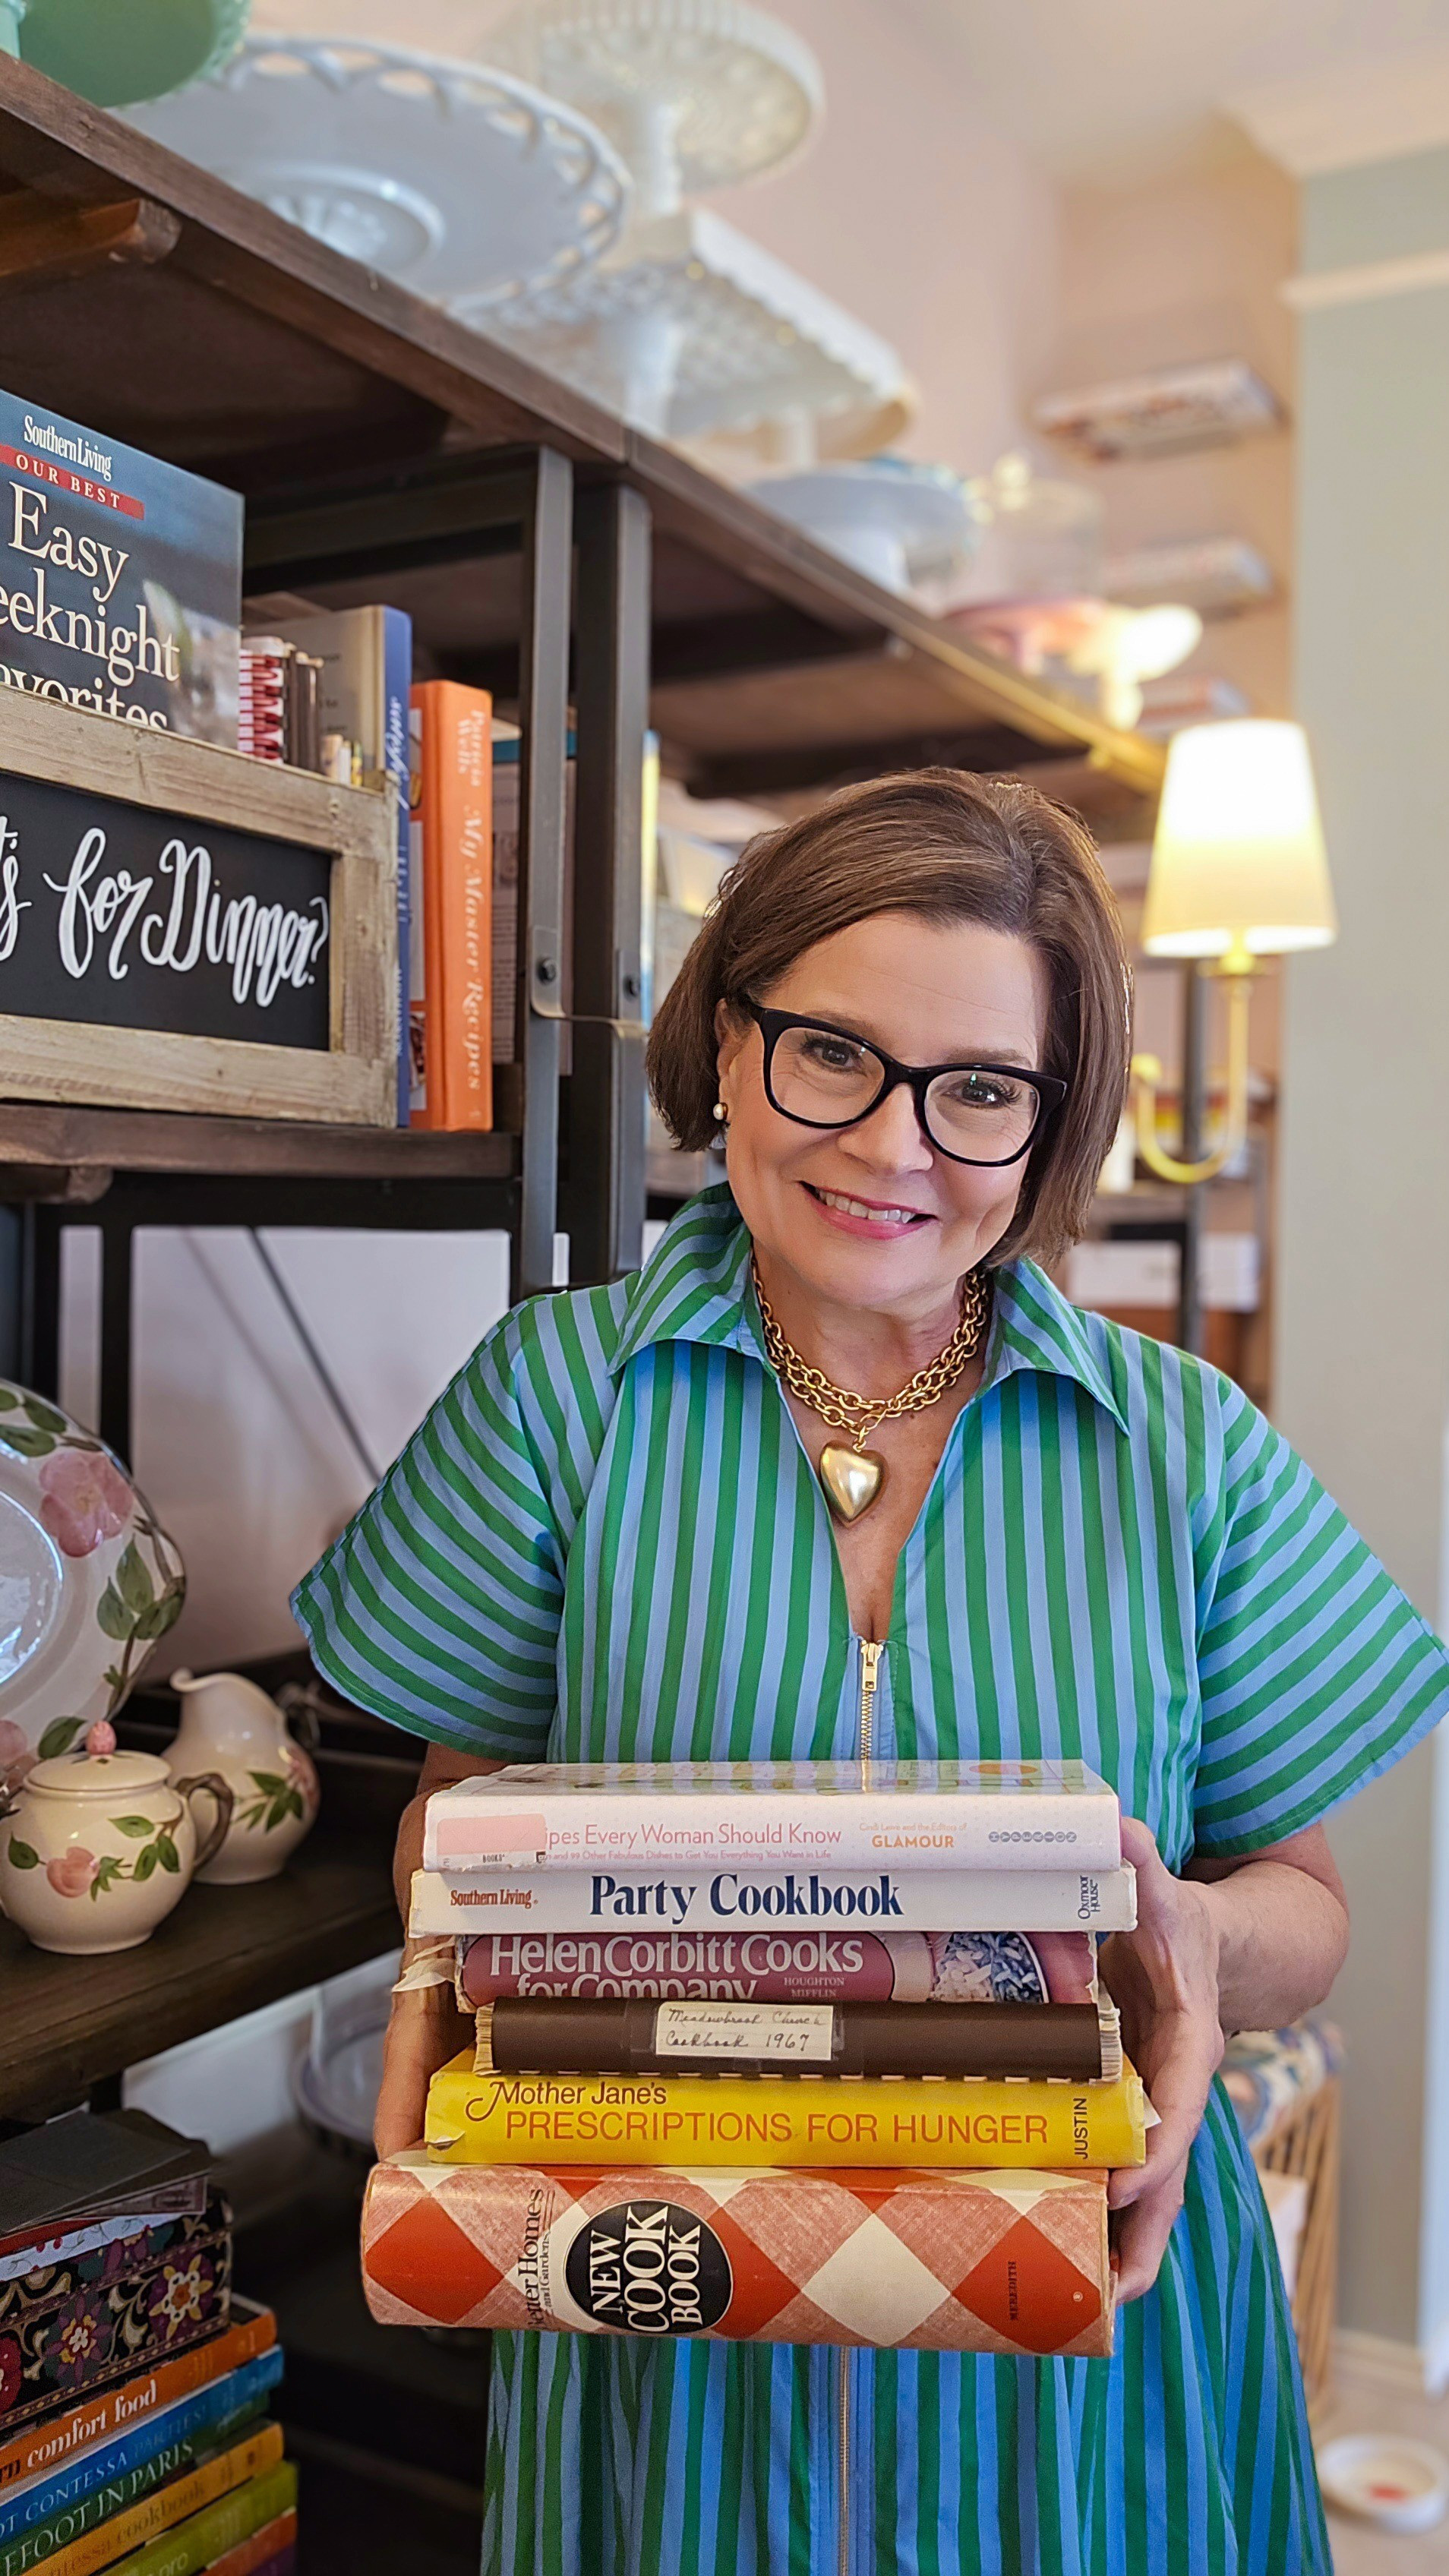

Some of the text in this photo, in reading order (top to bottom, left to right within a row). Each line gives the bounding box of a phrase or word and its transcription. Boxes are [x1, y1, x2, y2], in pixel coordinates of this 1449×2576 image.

[24, 415, 112, 481] Southern Living
[16, 454, 121, 510] OUR BEST
[8, 481, 130, 602] Easy
[458, 720, 471, 773] Wells
[470, 709, 485, 786] Patricia
[43, 827, 153, 980] for
[140, 839, 329, 1007] Dinner?
[459, 806, 485, 1089] My Master Recipes
[585, 1823, 638, 1849] Every
[641, 1823, 714, 1844] Woman
[718, 1823, 782, 1844] Should
[788, 1823, 841, 1844] Know
[872, 1835, 955, 1848] GLAMOUR
[902, 1823, 917, 1831] and
[917, 1823, 930, 1831] the
[958, 1822, 968, 1831] of
[554, 1851, 567, 1859] and
[582, 1850, 606, 1859] Other
[608, 1850, 644, 1859] Fabulous
[646, 1850, 673, 1859] Dishes
[685, 1850, 701, 1859] Get
[703, 1850, 718, 1859] You
[721, 1849, 763, 1861] Everything
[766, 1850, 781, 1858] You
[782, 1850, 803, 1858] Want
[815, 1849, 832, 1858] Life
[450, 1889, 532, 1909] Southern Living
[589, 1873, 904, 1925] Party Cookbook
[1078, 1875, 1089, 1920] Oxmoor
[491, 1933, 864, 1977] Helen Corbitt Cooks
[784, 1977, 844, 1986] HOUGHTON
[668, 2008, 826, 2026] Meadowbrook Church
[791, 1988, 837, 1997] MIFFLIN
[665, 2030, 810, 2051] Cookbook 1967
[465, 2081, 667, 2122] Mother Jane's
[506, 2110, 1047, 2145] PRESCRIPTIONS FOR HUNGER
[1073, 2097, 1088, 2160] JUSTIN
[518, 2189, 544, 2277] Homes
[539, 2230, 552, 2307] and Gardens
[589, 2229, 623, 2313] NEW
[623, 2205, 670, 2333] COOK
[668, 2224, 703, 2325] BOOK
[1008, 2261, 1018, 2320] MEREDITH
[27, 2408, 107, 2468] comfort
[113, 2379, 157, 2423] food
[25, 2451, 128, 2521] CONTESSA
[97, 2477, 125, 2518] IN
[129, 2437, 194, 2493] PARIS
